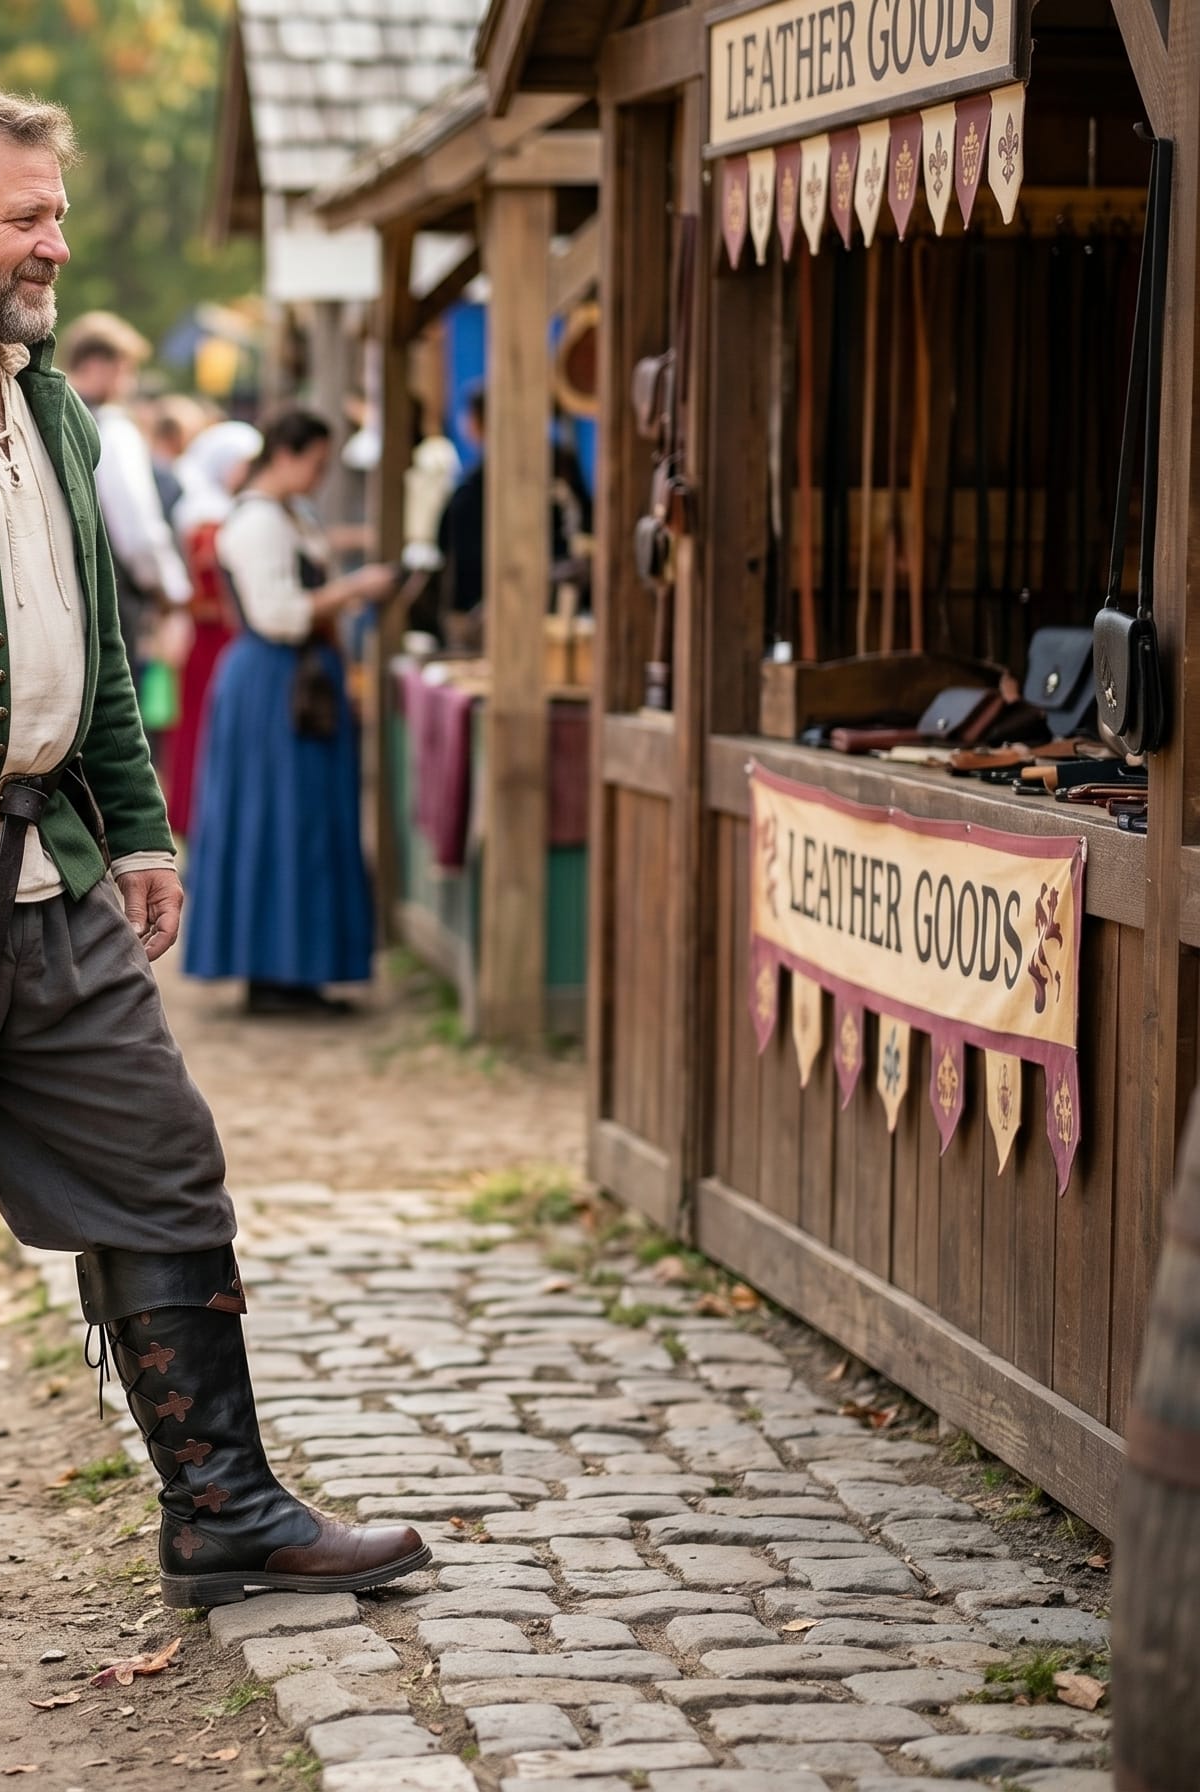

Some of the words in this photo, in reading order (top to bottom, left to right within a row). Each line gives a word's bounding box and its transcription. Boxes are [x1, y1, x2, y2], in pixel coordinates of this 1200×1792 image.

[725, 2, 856, 121] LEATHER
[788, 829, 902, 954] LEATHER
[914, 869, 1023, 990] GOODS
